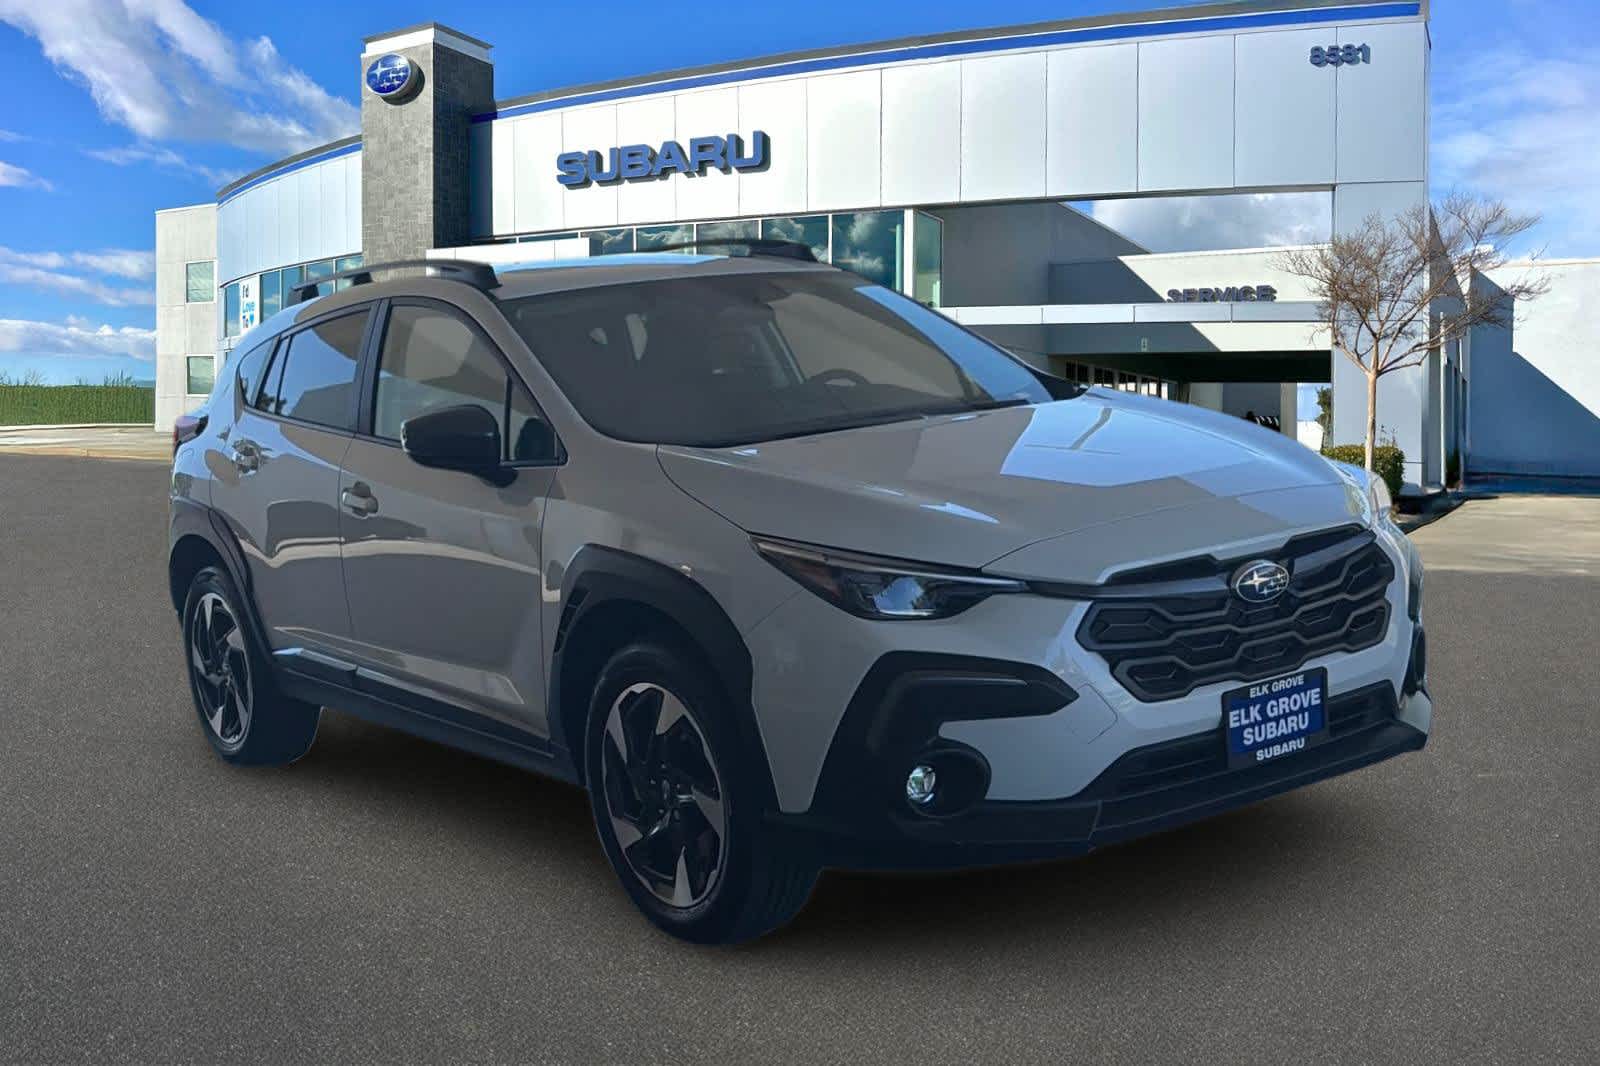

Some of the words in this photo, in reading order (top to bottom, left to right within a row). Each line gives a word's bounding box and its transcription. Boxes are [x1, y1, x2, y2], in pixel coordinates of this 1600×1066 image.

[556, 130, 770, 190] SUBARU
[1167, 285, 1277, 302] SERVICE
[1249, 683, 1270, 698] ELK
[1271, 674, 1305, 692] GROVE
[1229, 703, 1262, 728] ELK
[1266, 688, 1321, 718] GROVE
[1243, 711, 1309, 745] SUBARU
[1256, 737, 1305, 761] SUBARU
